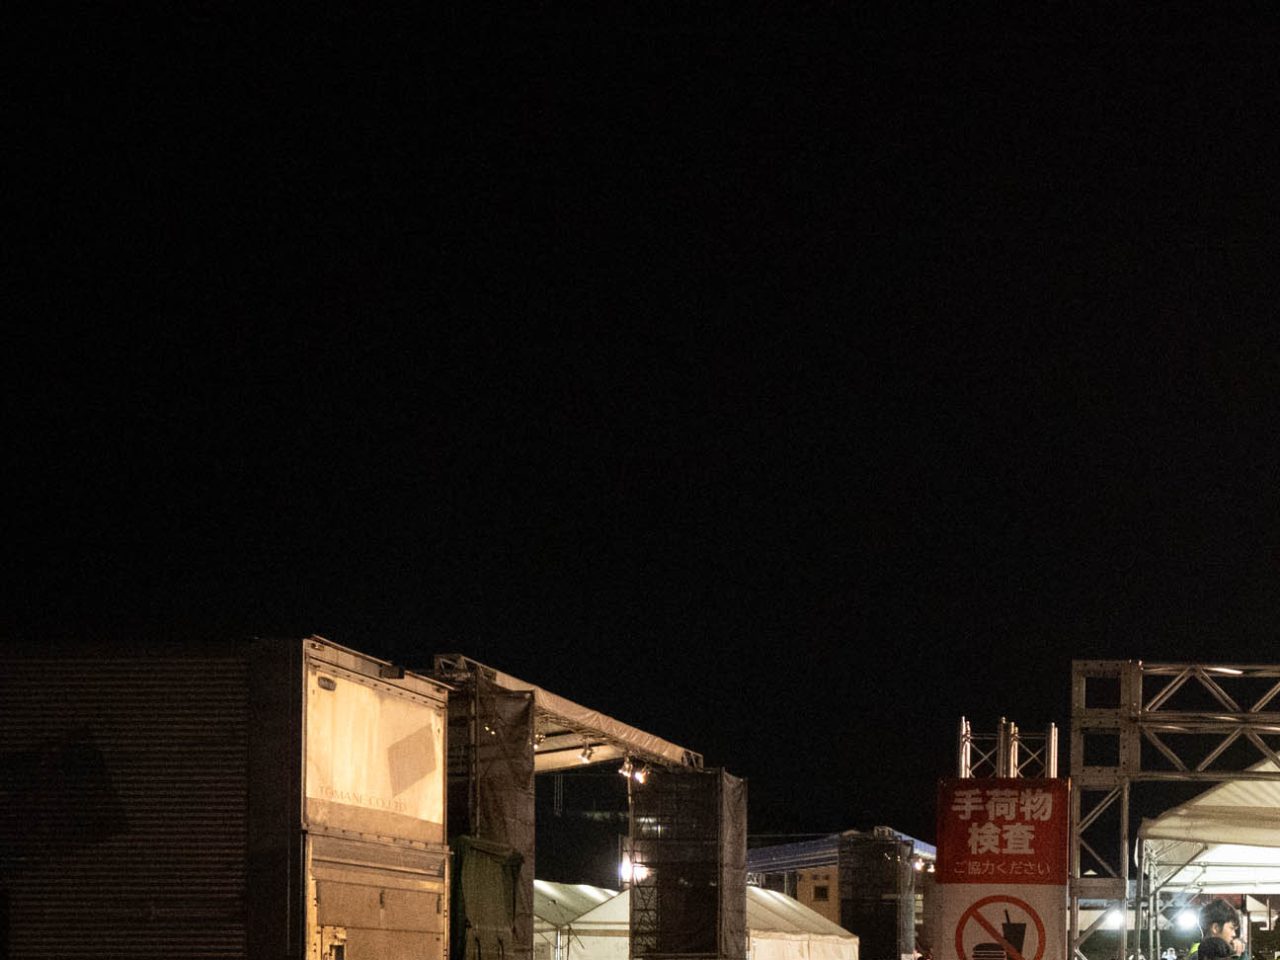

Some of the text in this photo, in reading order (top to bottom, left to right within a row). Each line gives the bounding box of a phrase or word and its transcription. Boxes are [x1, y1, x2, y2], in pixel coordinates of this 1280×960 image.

[952, 788, 1053, 821] 手荷物
[967, 822, 1035, 855] 検査
[954, 860, 1051, 875] ご協力ください
